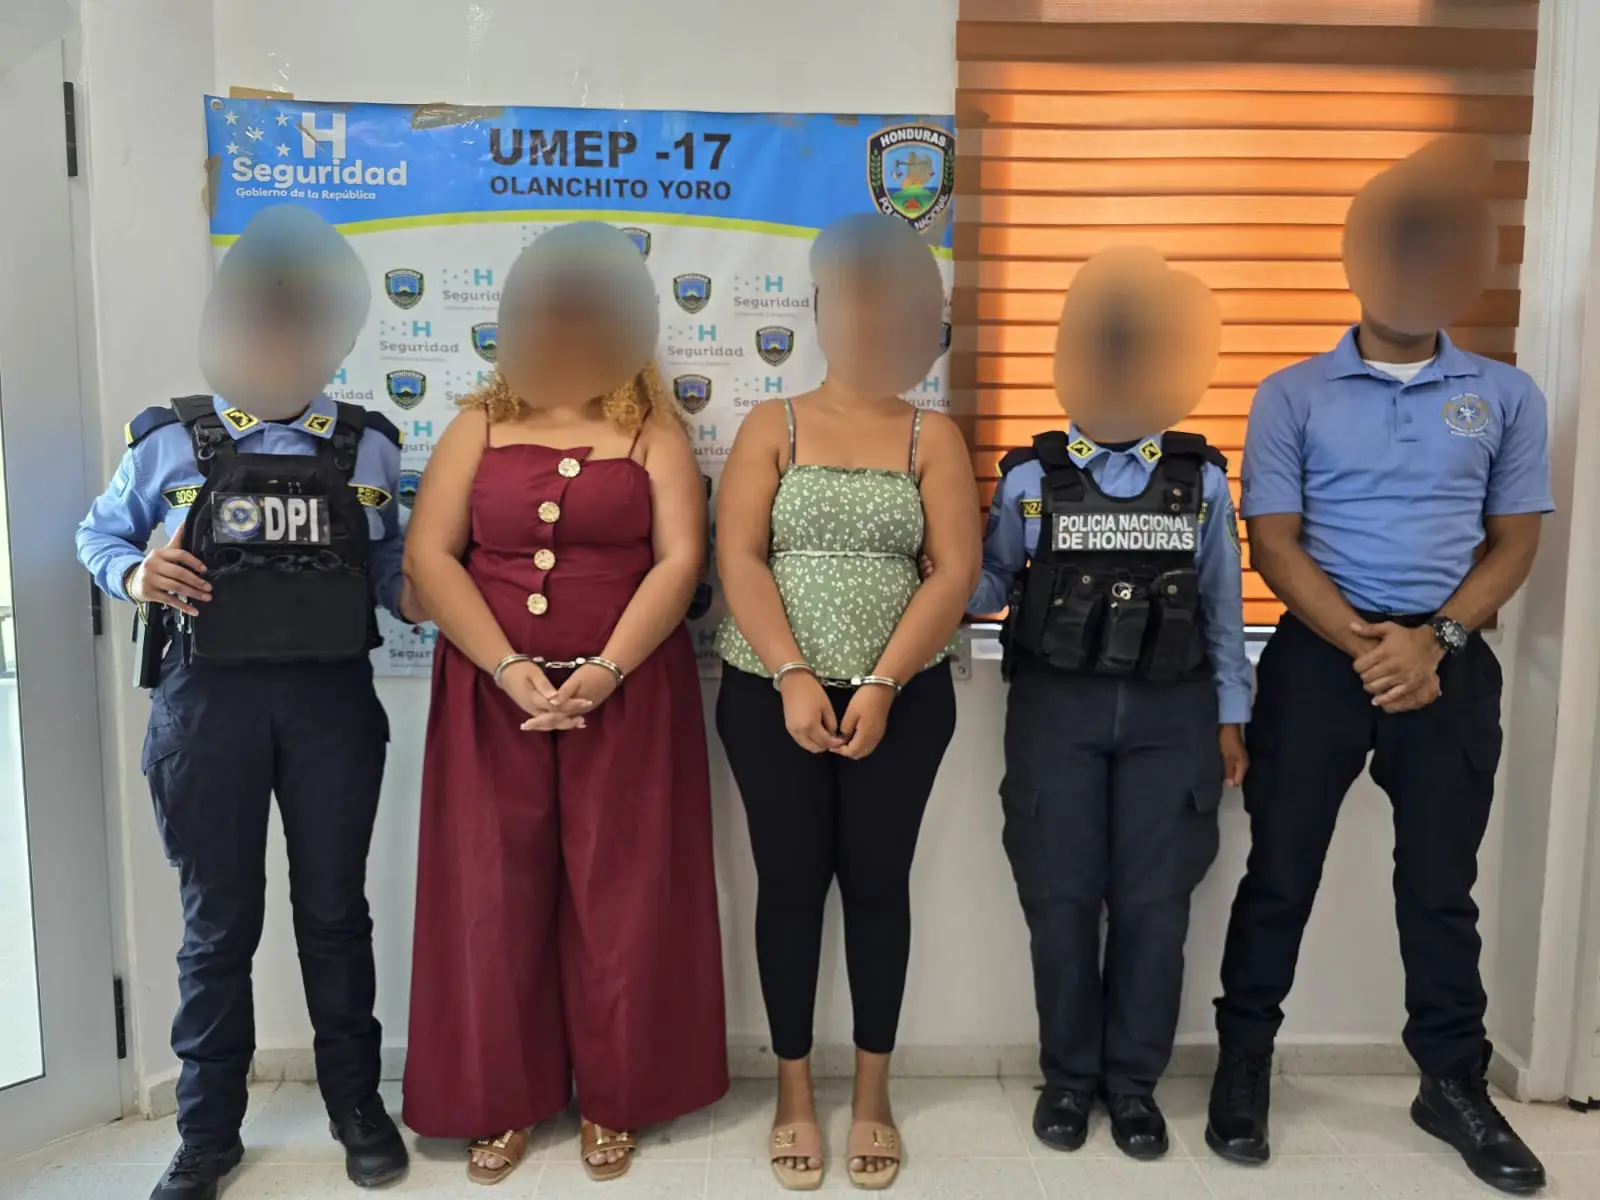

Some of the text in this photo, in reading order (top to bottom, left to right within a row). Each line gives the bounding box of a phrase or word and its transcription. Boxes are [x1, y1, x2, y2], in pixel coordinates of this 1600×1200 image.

[302, 112, 346, 158] H
[880, 128, 947, 147] HONDURAS
[490, 128, 731, 170] UMEP -17
[231, 156, 408, 188] Seguridad
[236, 187, 376, 201] Gobierno de la República
[491, 176, 731, 200] OLANCHITO YORO
[473, 268, 493, 286] H
[765, 275, 783, 293] H
[442, 290, 500, 303] Segurid
[733, 296, 810, 309] Seguridad
[412, 320, 431, 338] H
[698, 324, 717, 341] H
[379, 340, 459, 353] Seguridad
[667, 345, 744, 358] Seguridad
[764, 376, 783, 393] H
[413, 420, 432, 437] H
[698, 424, 717, 441] H
[264, 496, 319, 542] DPI
[1059, 515, 1193, 532] POLICIA NACIONAL
[1058, 532, 1194, 549] DE HONDURAS
